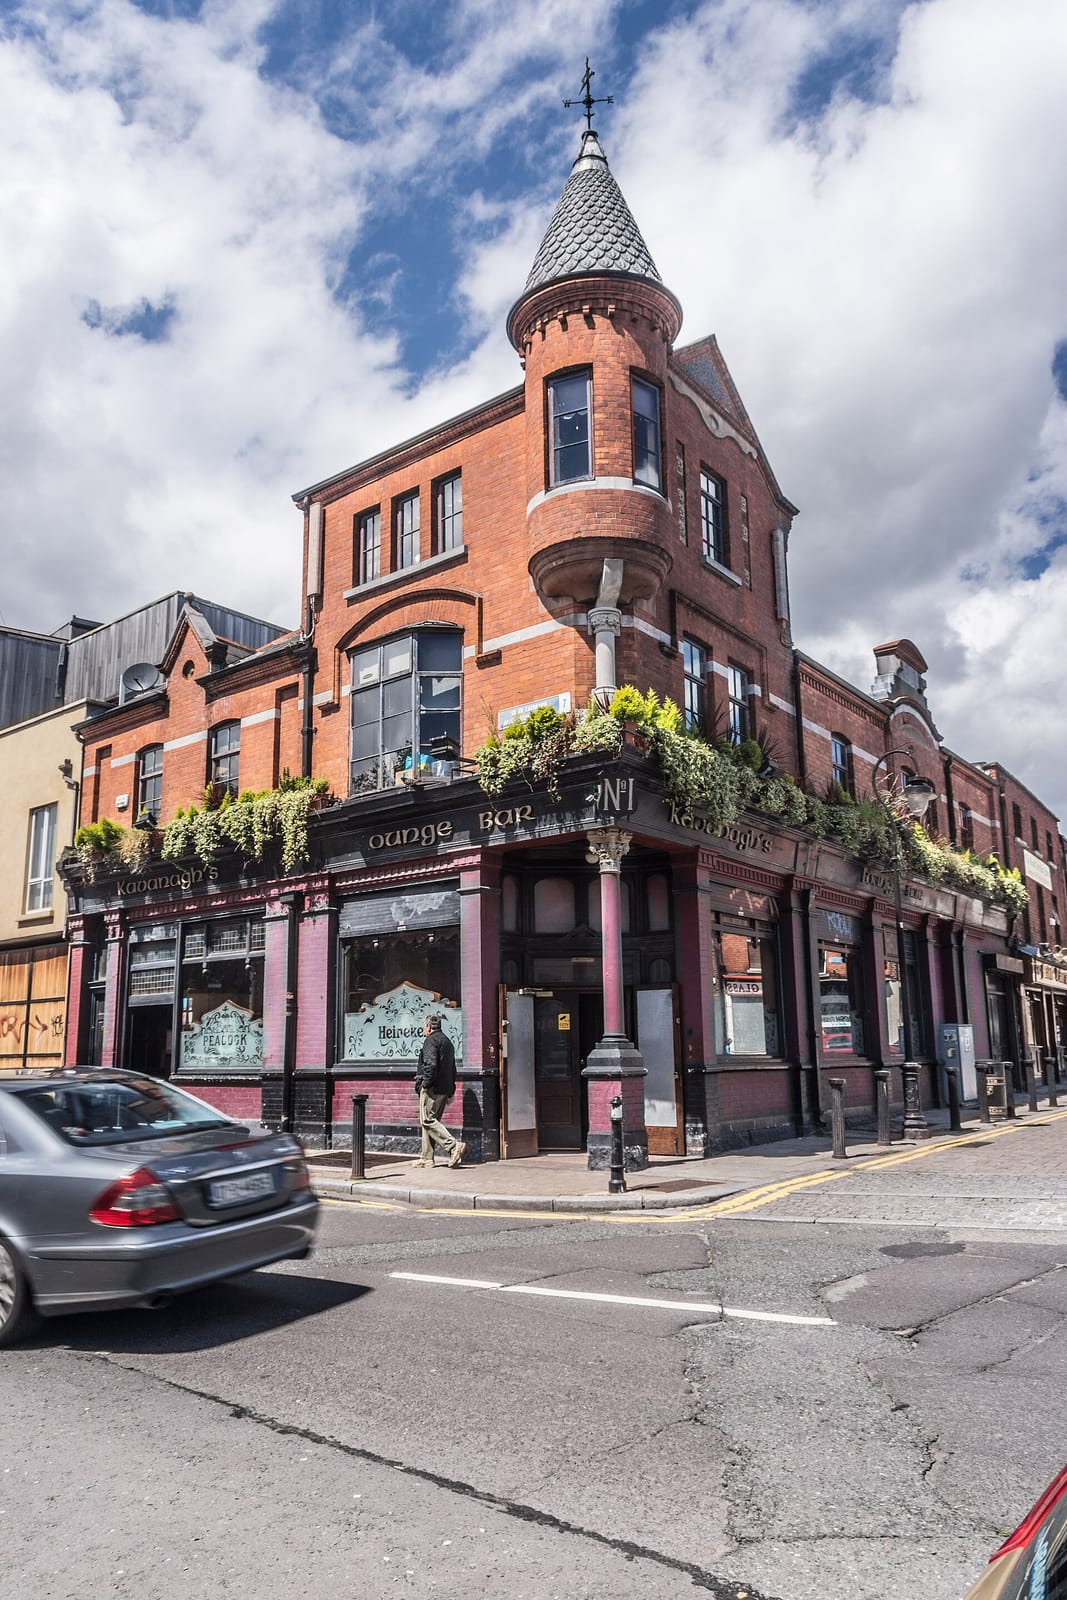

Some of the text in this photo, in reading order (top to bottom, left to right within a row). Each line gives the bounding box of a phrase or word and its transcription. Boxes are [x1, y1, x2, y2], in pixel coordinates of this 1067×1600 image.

[368, 819, 453, 849] ounge
[116, 864, 220, 896] Kavanagh's
[378, 1025, 427, 1040] Heineke
